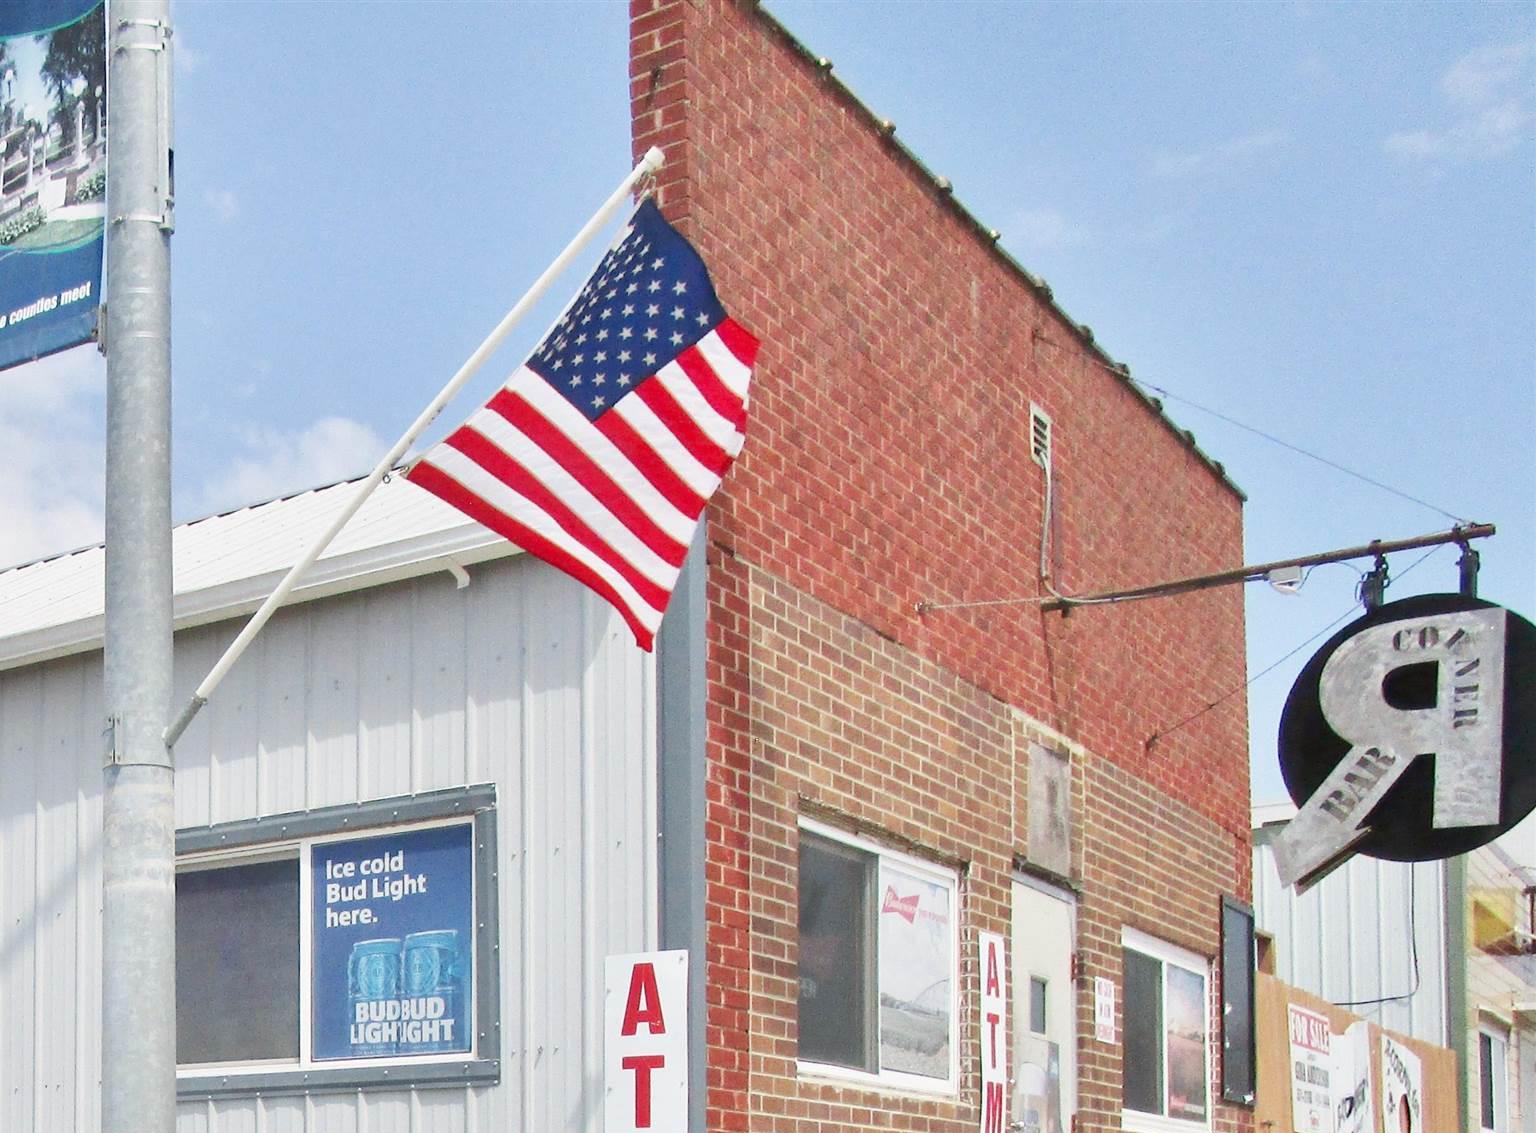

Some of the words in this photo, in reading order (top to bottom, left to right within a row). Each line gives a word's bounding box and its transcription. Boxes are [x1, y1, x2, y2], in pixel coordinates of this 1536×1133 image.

[9, 295, 58, 325] counties
[60, 281, 92, 306] meet
[1320, 747, 1396, 823] BAR
[326, 859, 355, 879] Ice
[360, 850, 404, 875] cold
[326, 879, 367, 904] Bud
[372, 873, 427, 901] Light
[326, 907, 379, 928] here.
[355, 1000, 401, 1023] BUD
[401, 996, 445, 1021] BUD
[1290, 1011, 1308, 1044] FOR
[1310, 1019, 1329, 1050] SALE
